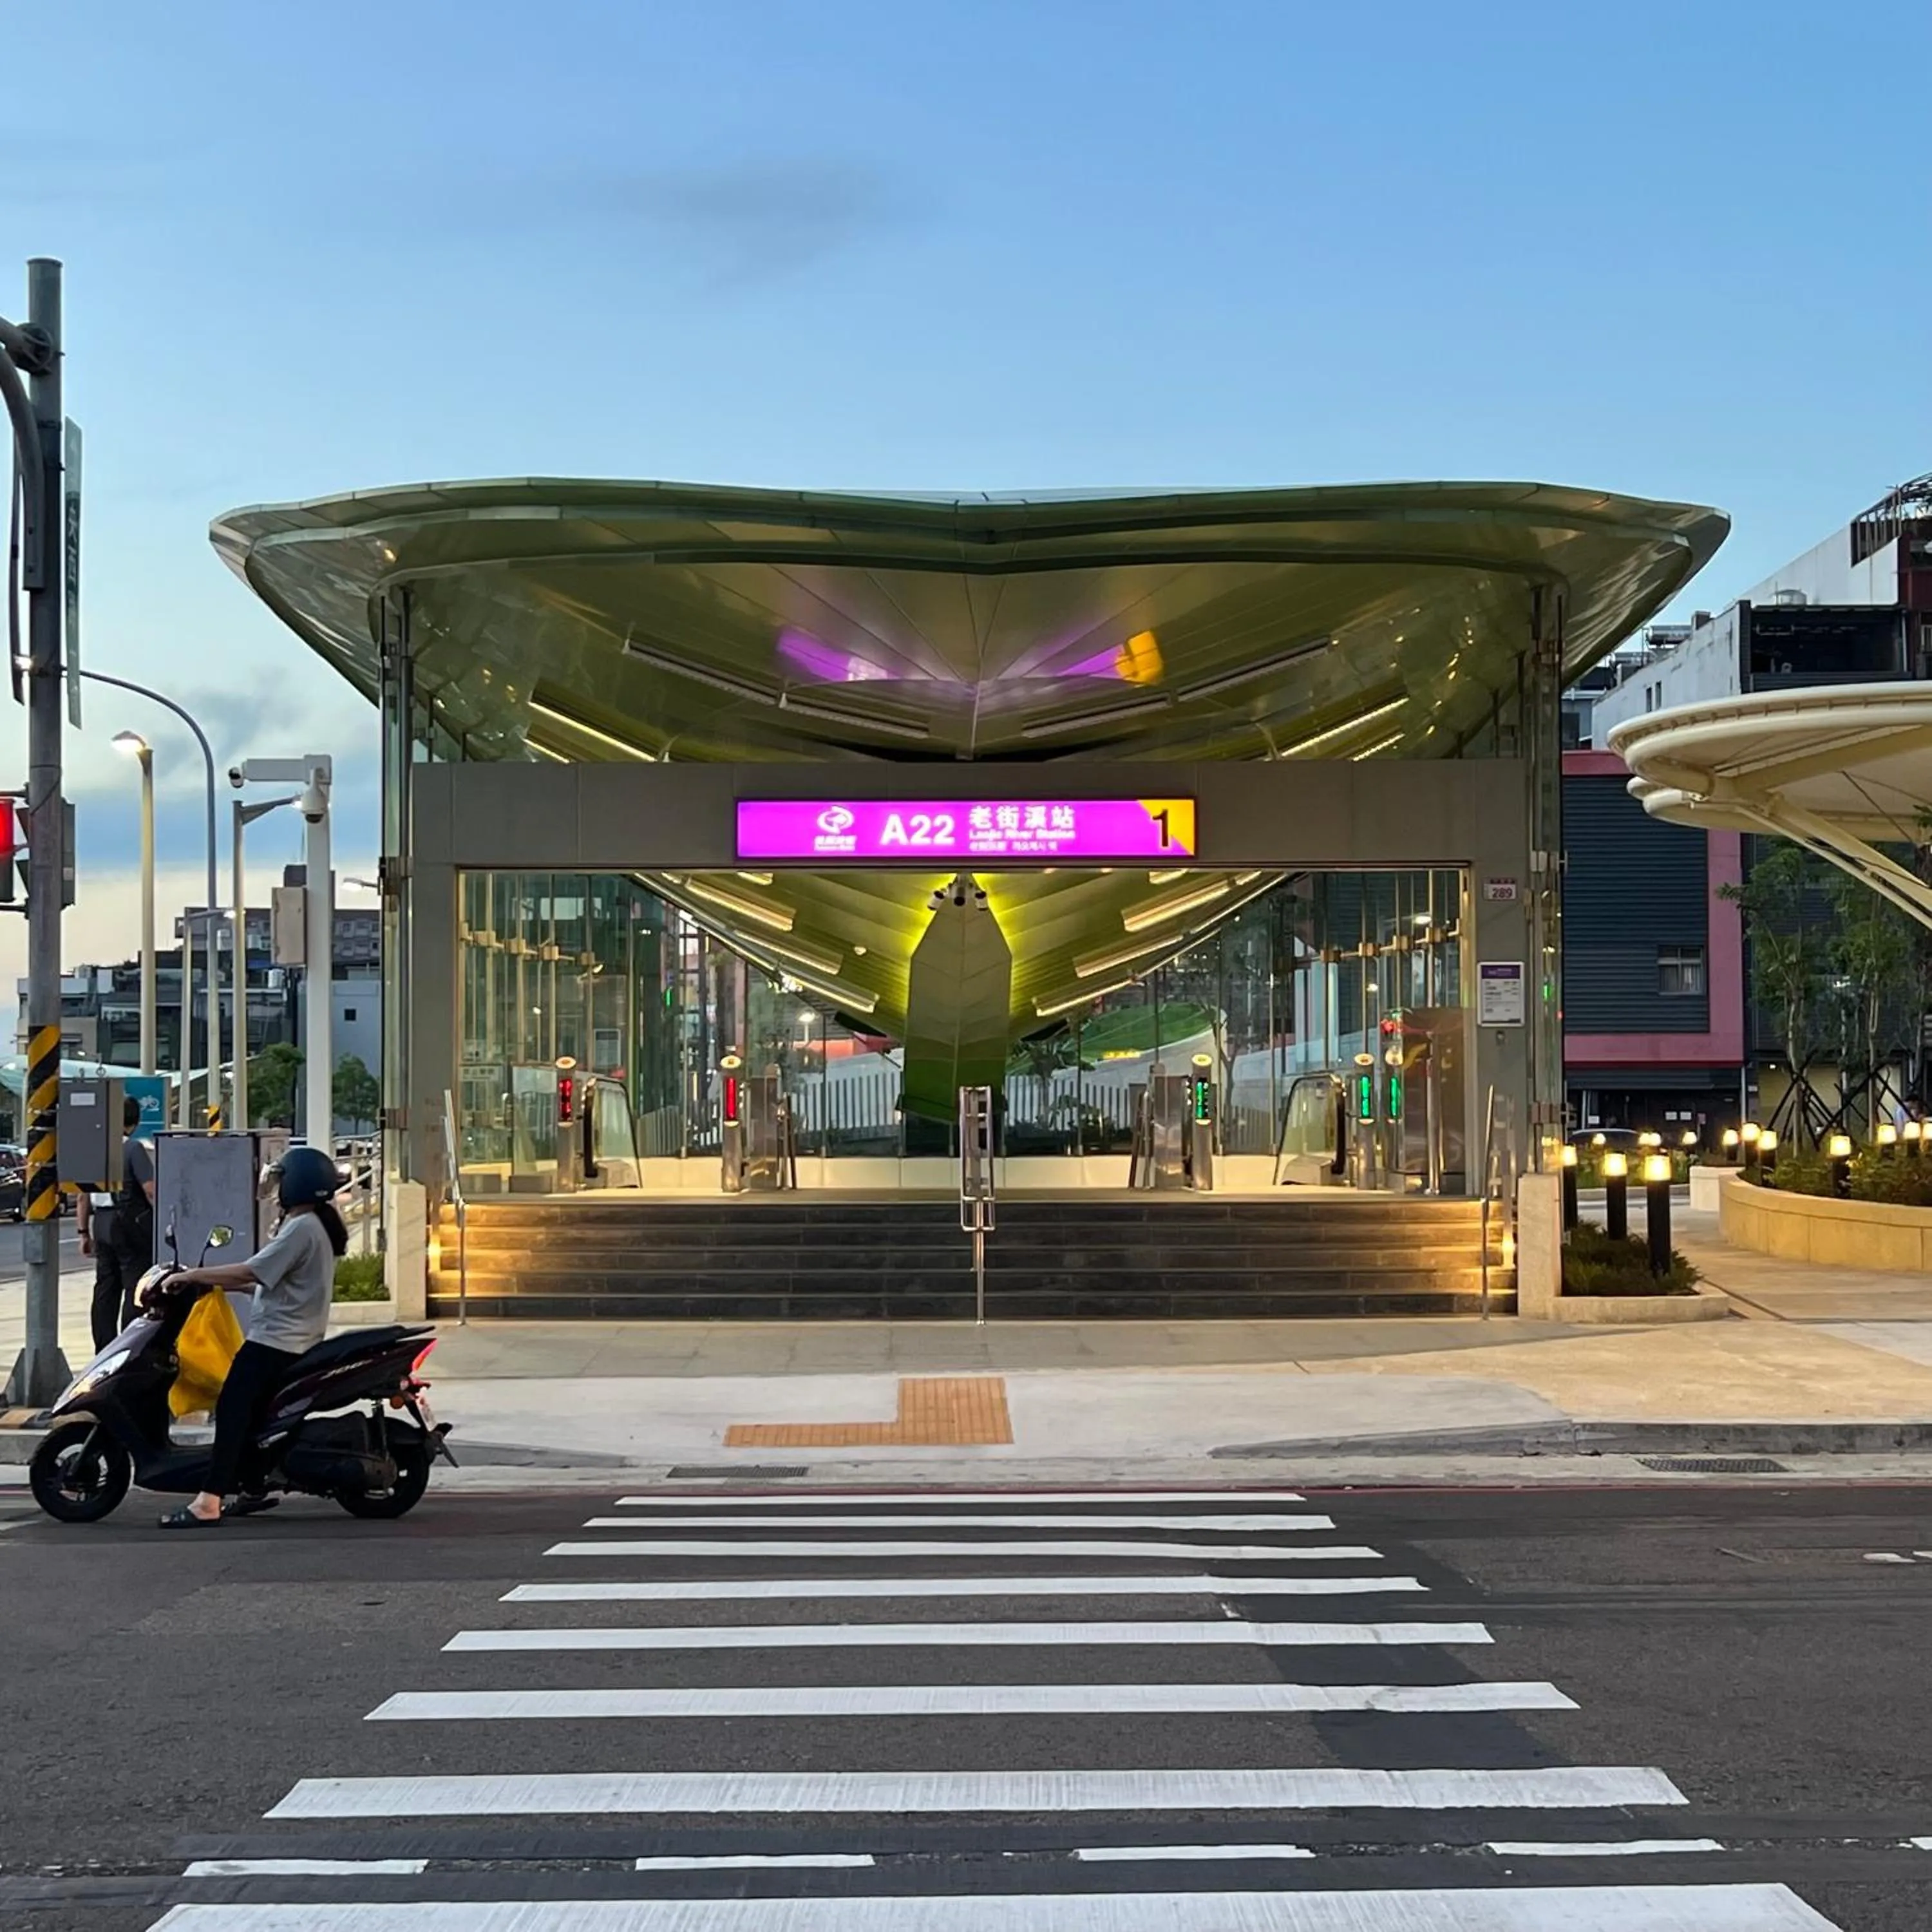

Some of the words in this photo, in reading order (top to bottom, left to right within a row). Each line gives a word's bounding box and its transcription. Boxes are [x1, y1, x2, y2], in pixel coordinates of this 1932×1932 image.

[879, 813, 956, 846] A22
[969, 805, 1075, 829] 老街溪站
[1152, 808, 1169, 848] 1
[1492, 887, 1513, 899] 289
